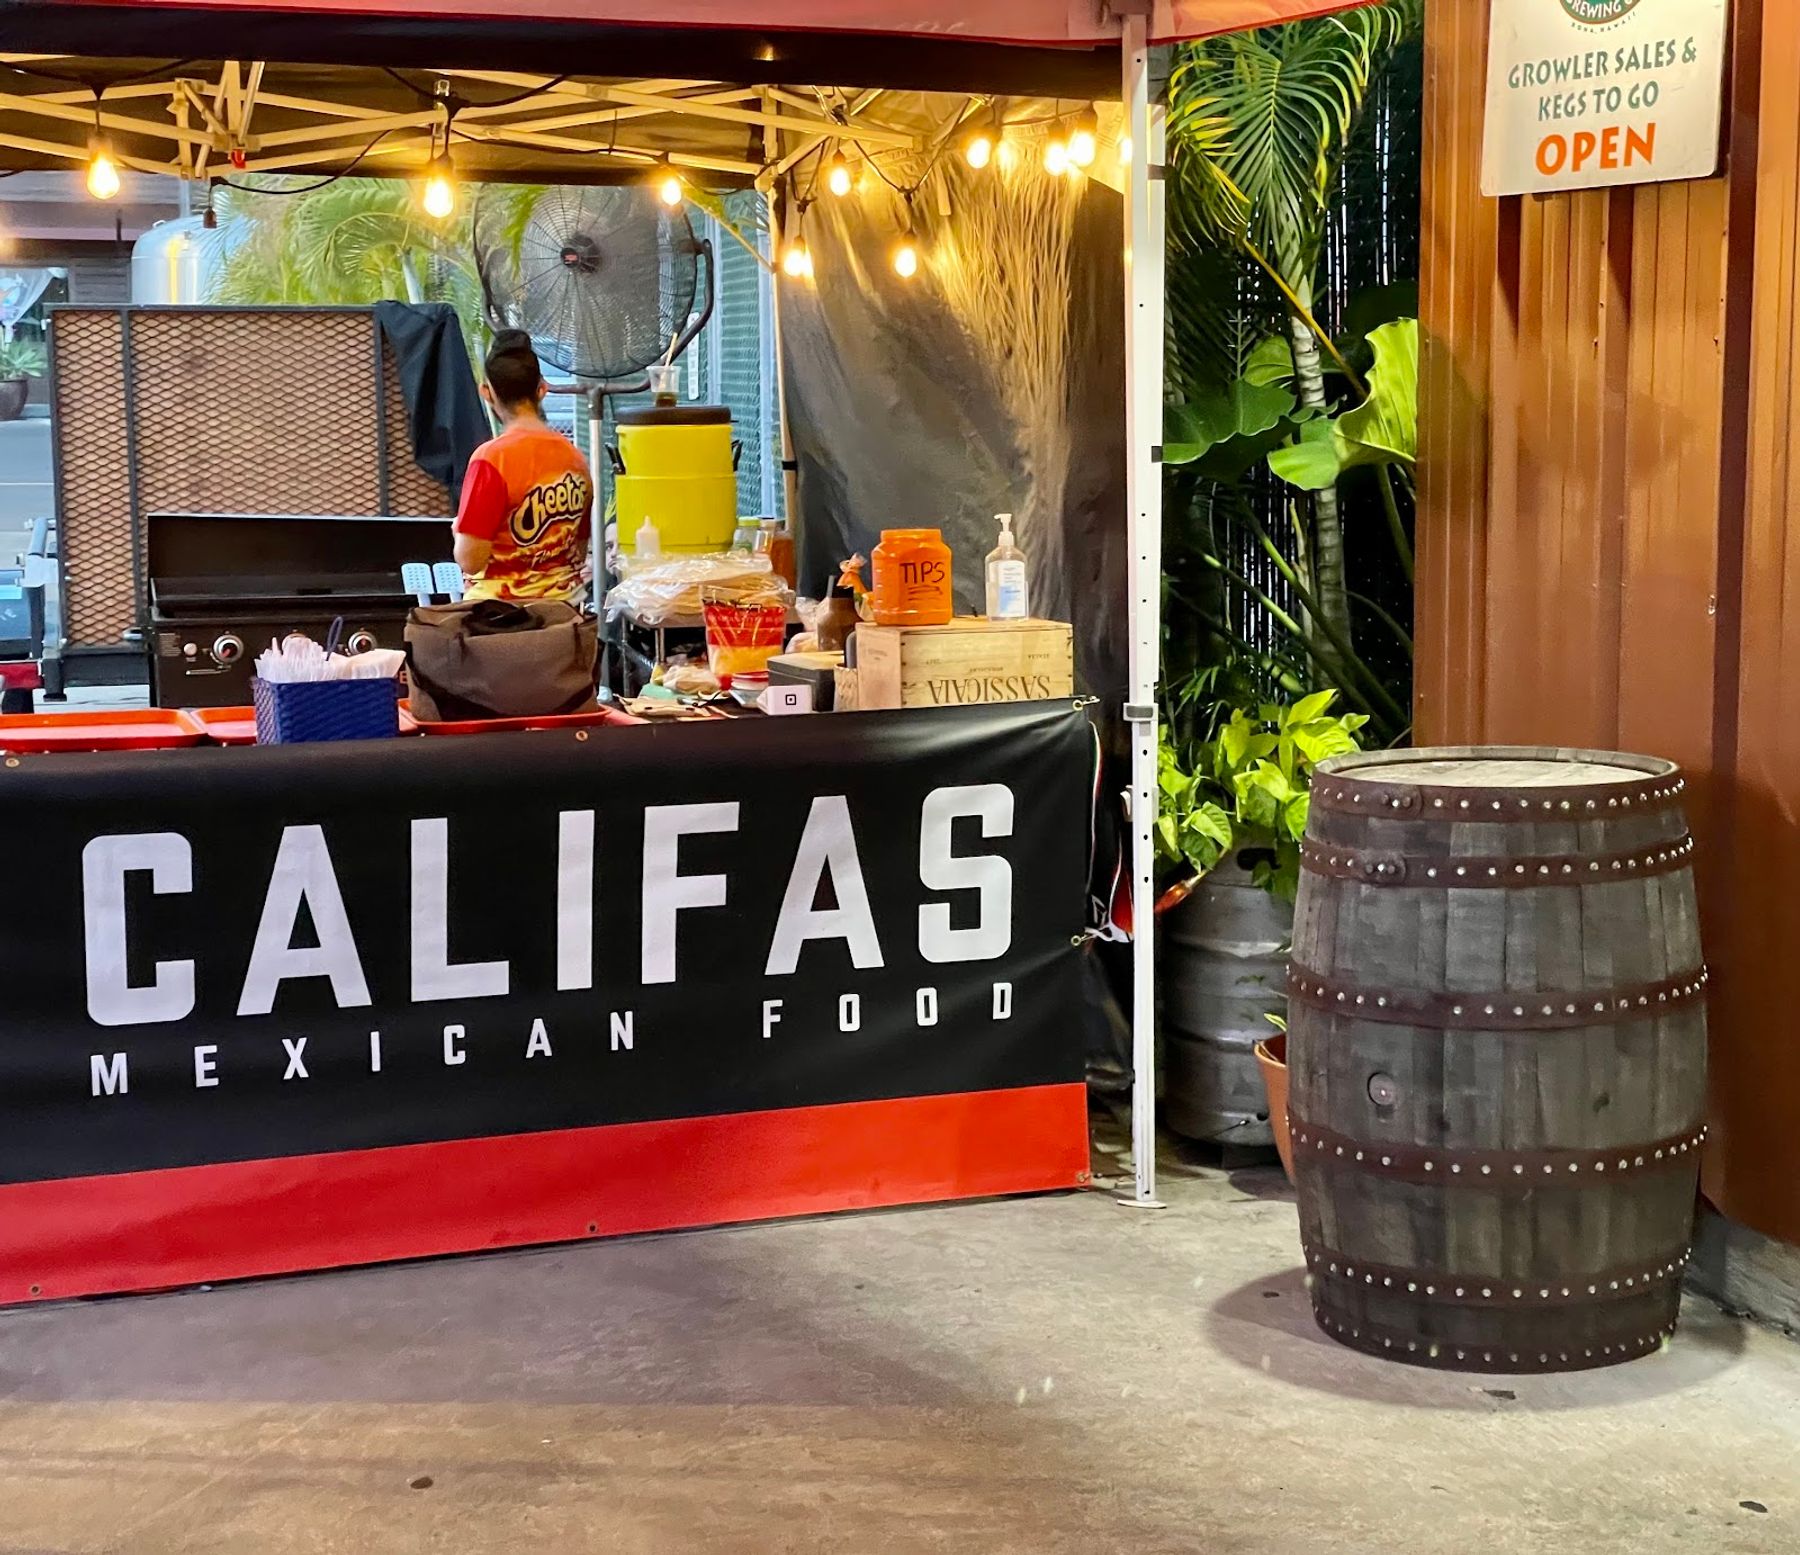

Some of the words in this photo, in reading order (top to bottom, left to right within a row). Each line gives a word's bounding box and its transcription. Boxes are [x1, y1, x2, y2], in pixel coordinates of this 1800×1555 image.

[1508, 51, 1609, 89] GROWLER
[1614, 39, 1676, 75] SALES
[1682, 36, 1697, 63] &
[1538, 90, 1587, 121] KEGS
[1593, 86, 1622, 114] TO
[1628, 80, 1659, 109] GO
[1535, 123, 1656, 176] OPEN
[900, 560, 946, 584] TIPS
[927, 675, 1050, 705] SASSICAIA
[82, 783, 1015, 1026] CALIFAS
[90, 1010, 635, 1097] MEXICAN
[762, 982, 1013, 1039] FOOD
